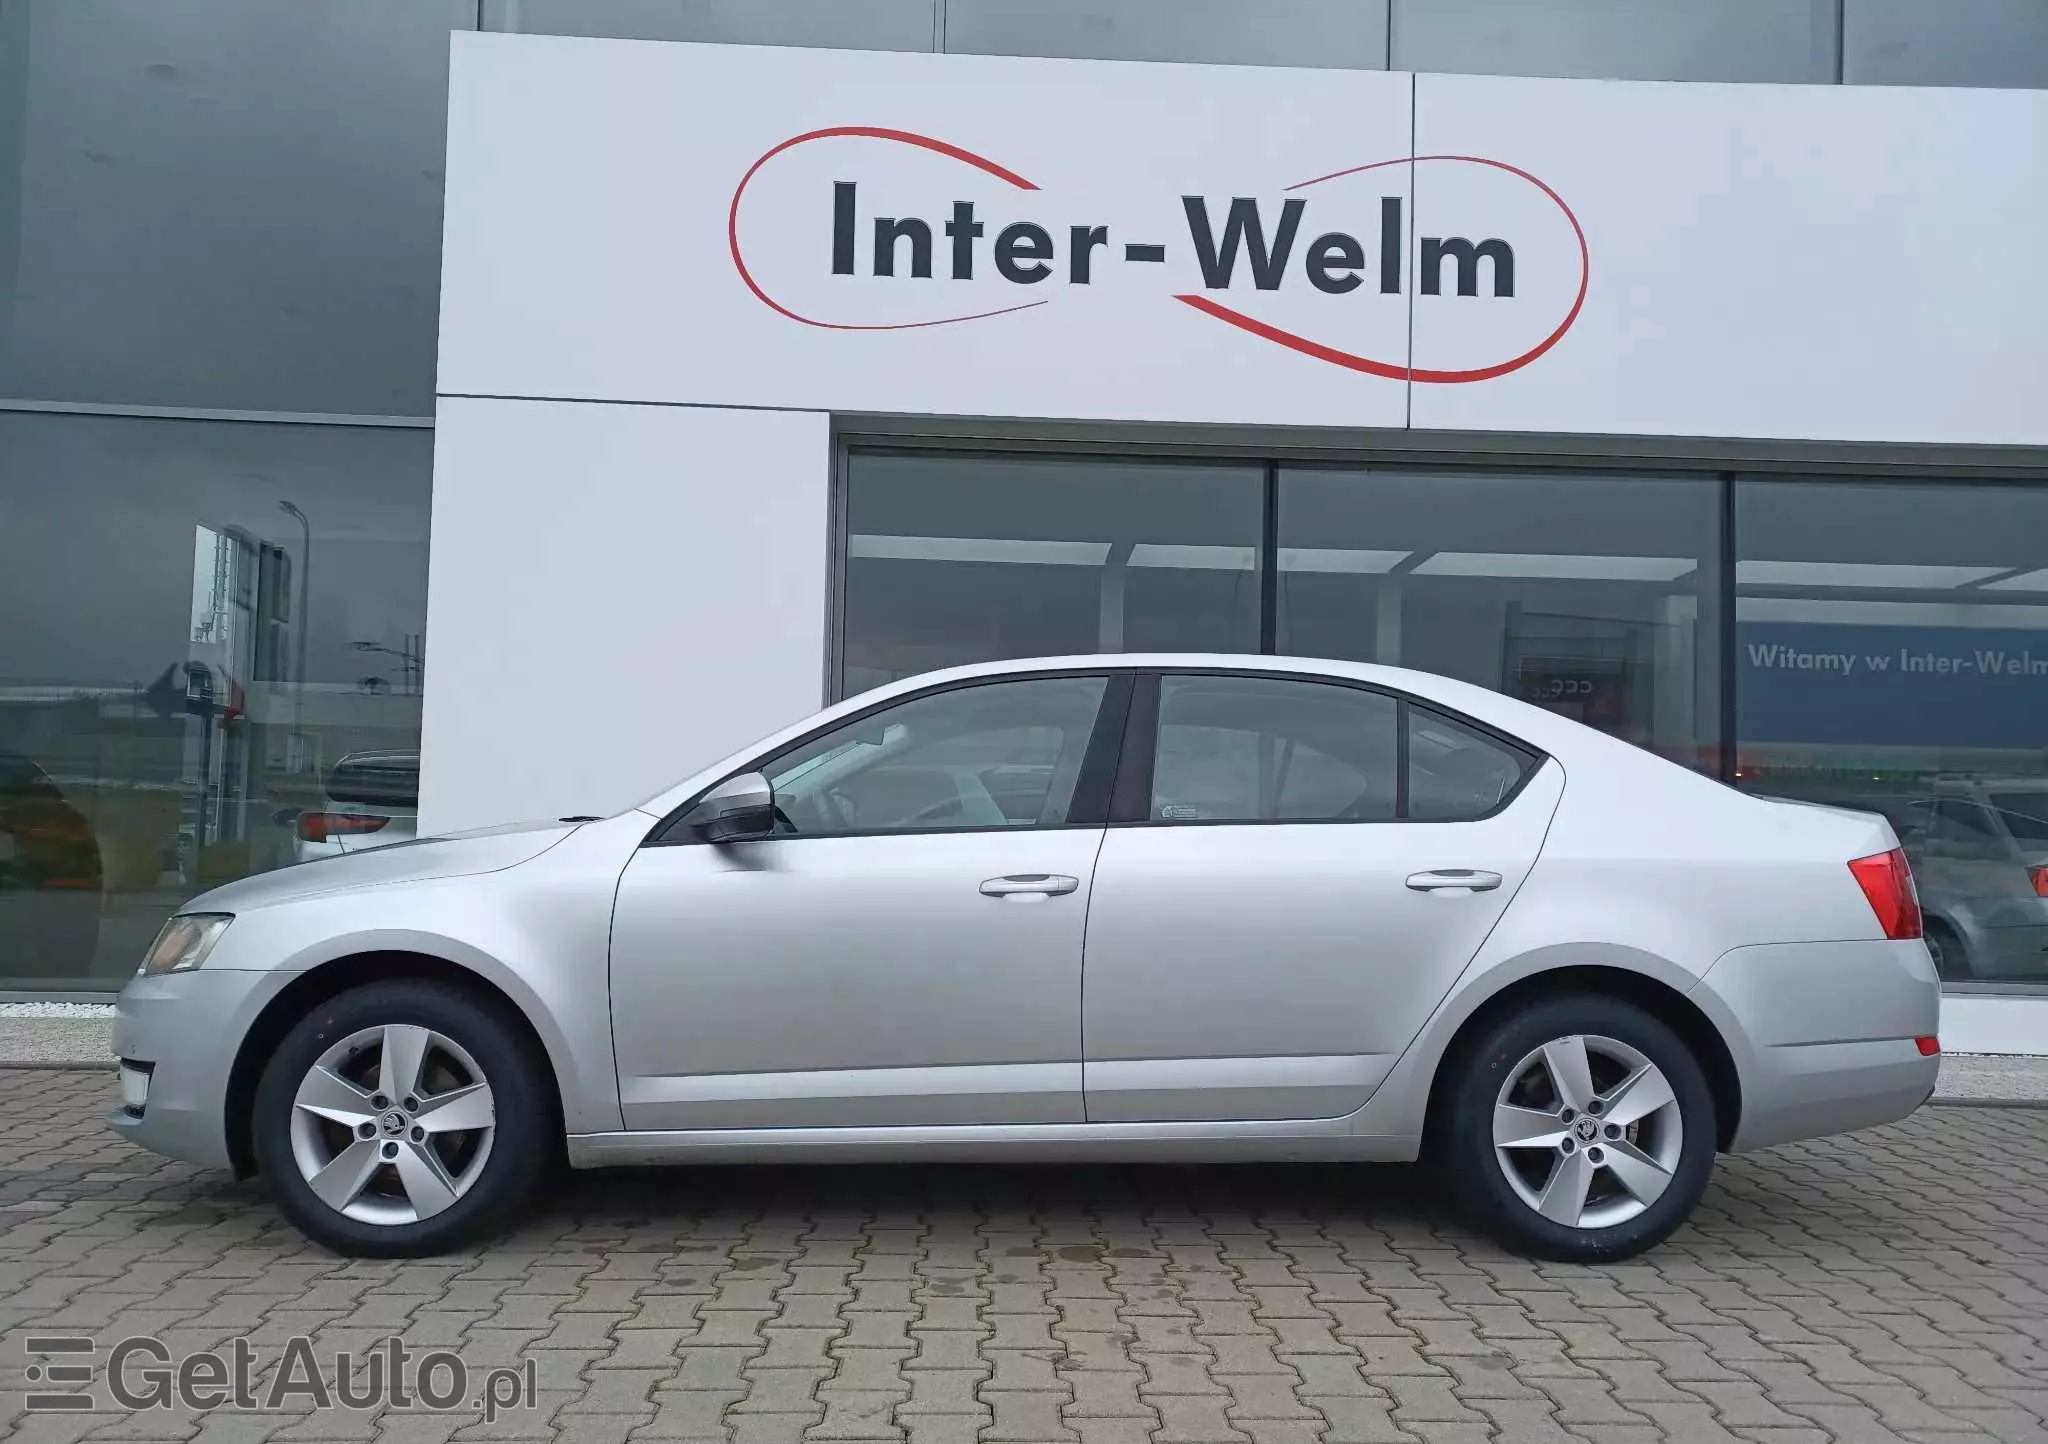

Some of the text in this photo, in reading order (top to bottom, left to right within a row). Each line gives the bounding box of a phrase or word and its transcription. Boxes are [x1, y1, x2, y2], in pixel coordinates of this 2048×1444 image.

[831, 180, 1517, 299] Inter-Welm
[1748, 644, 1856, 675] Witamy
[1865, 655, 1891, 671] w
